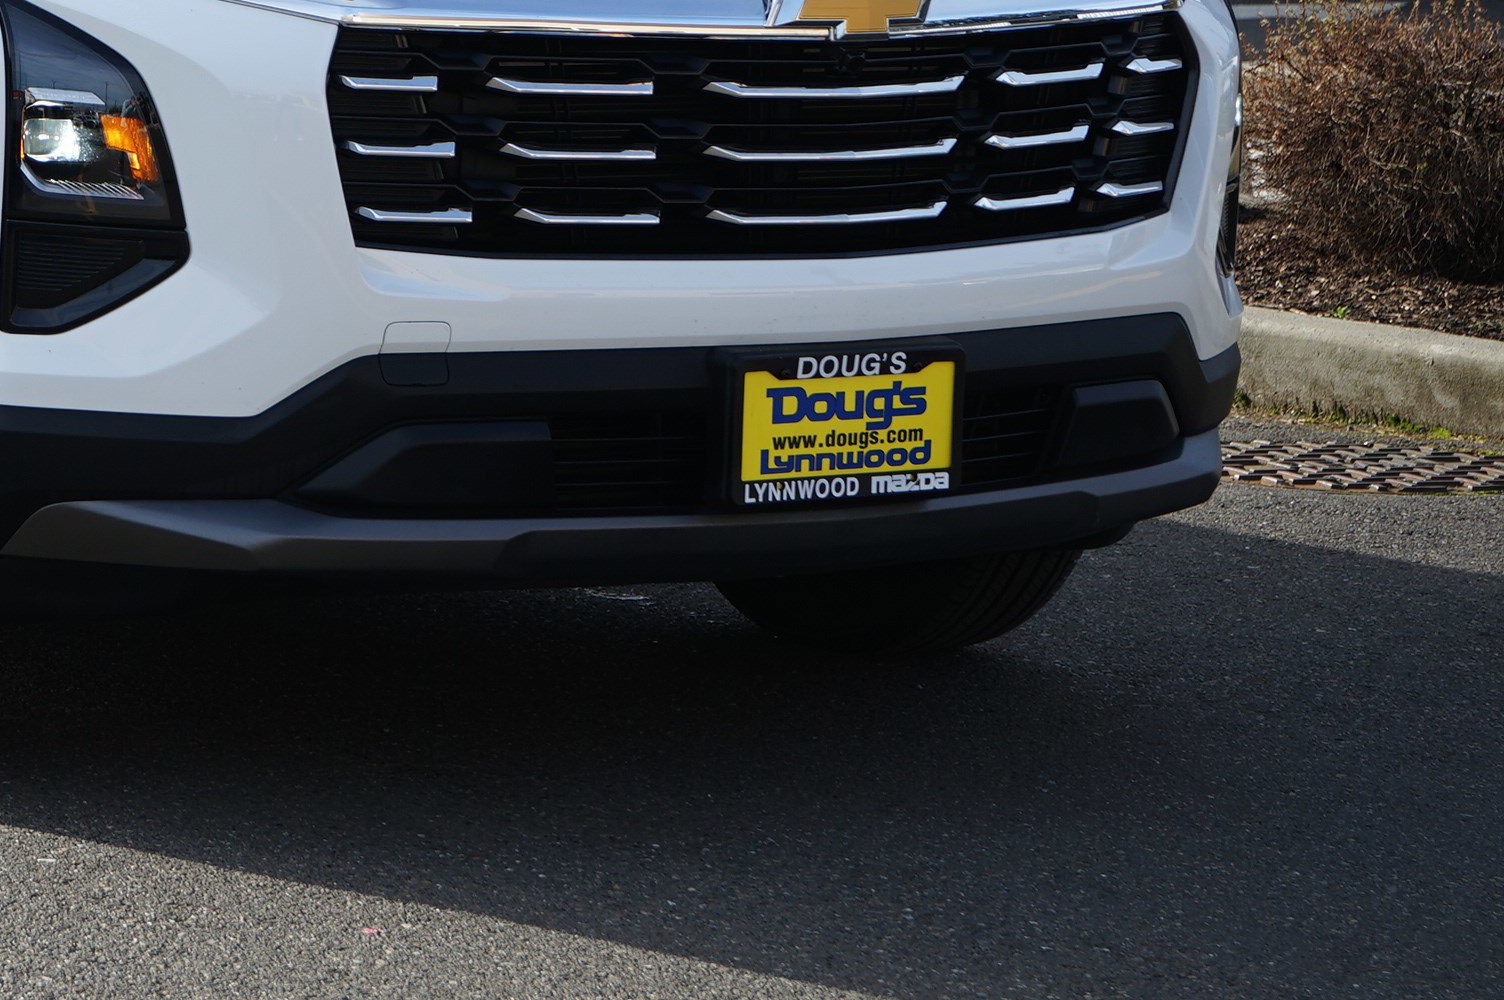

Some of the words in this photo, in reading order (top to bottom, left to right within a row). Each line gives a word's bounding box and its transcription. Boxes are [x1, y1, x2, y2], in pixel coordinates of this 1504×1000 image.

[797, 352, 907, 379] DOUG'S
[766, 381, 927, 430] Doug's
[773, 427, 923, 450] www.dougs.com
[760, 440, 931, 475] Lynnwood
[744, 477, 859, 503] LYNNWOOD
